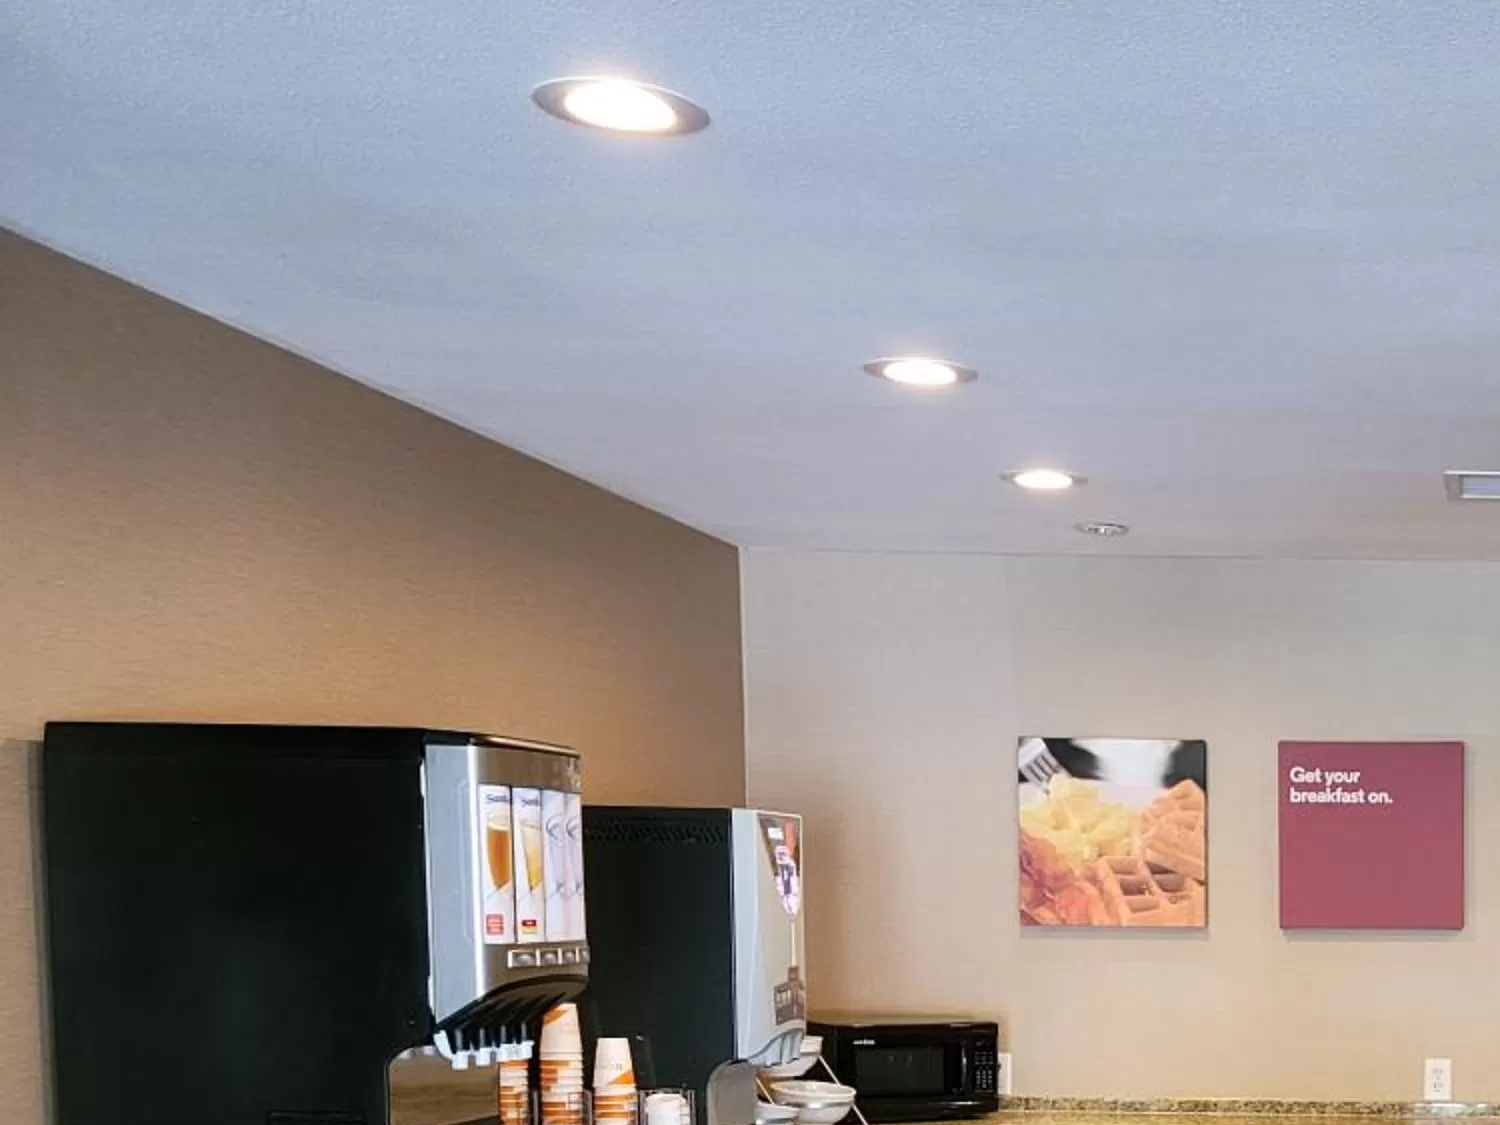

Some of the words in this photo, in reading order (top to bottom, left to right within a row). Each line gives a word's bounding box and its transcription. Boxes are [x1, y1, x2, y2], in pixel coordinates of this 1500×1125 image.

[1289, 766, 1322, 783] Get
[1324, 771, 1361, 787] your
[1289, 787, 1365, 803] breakfast
[1367, 791, 1393, 804] on.
